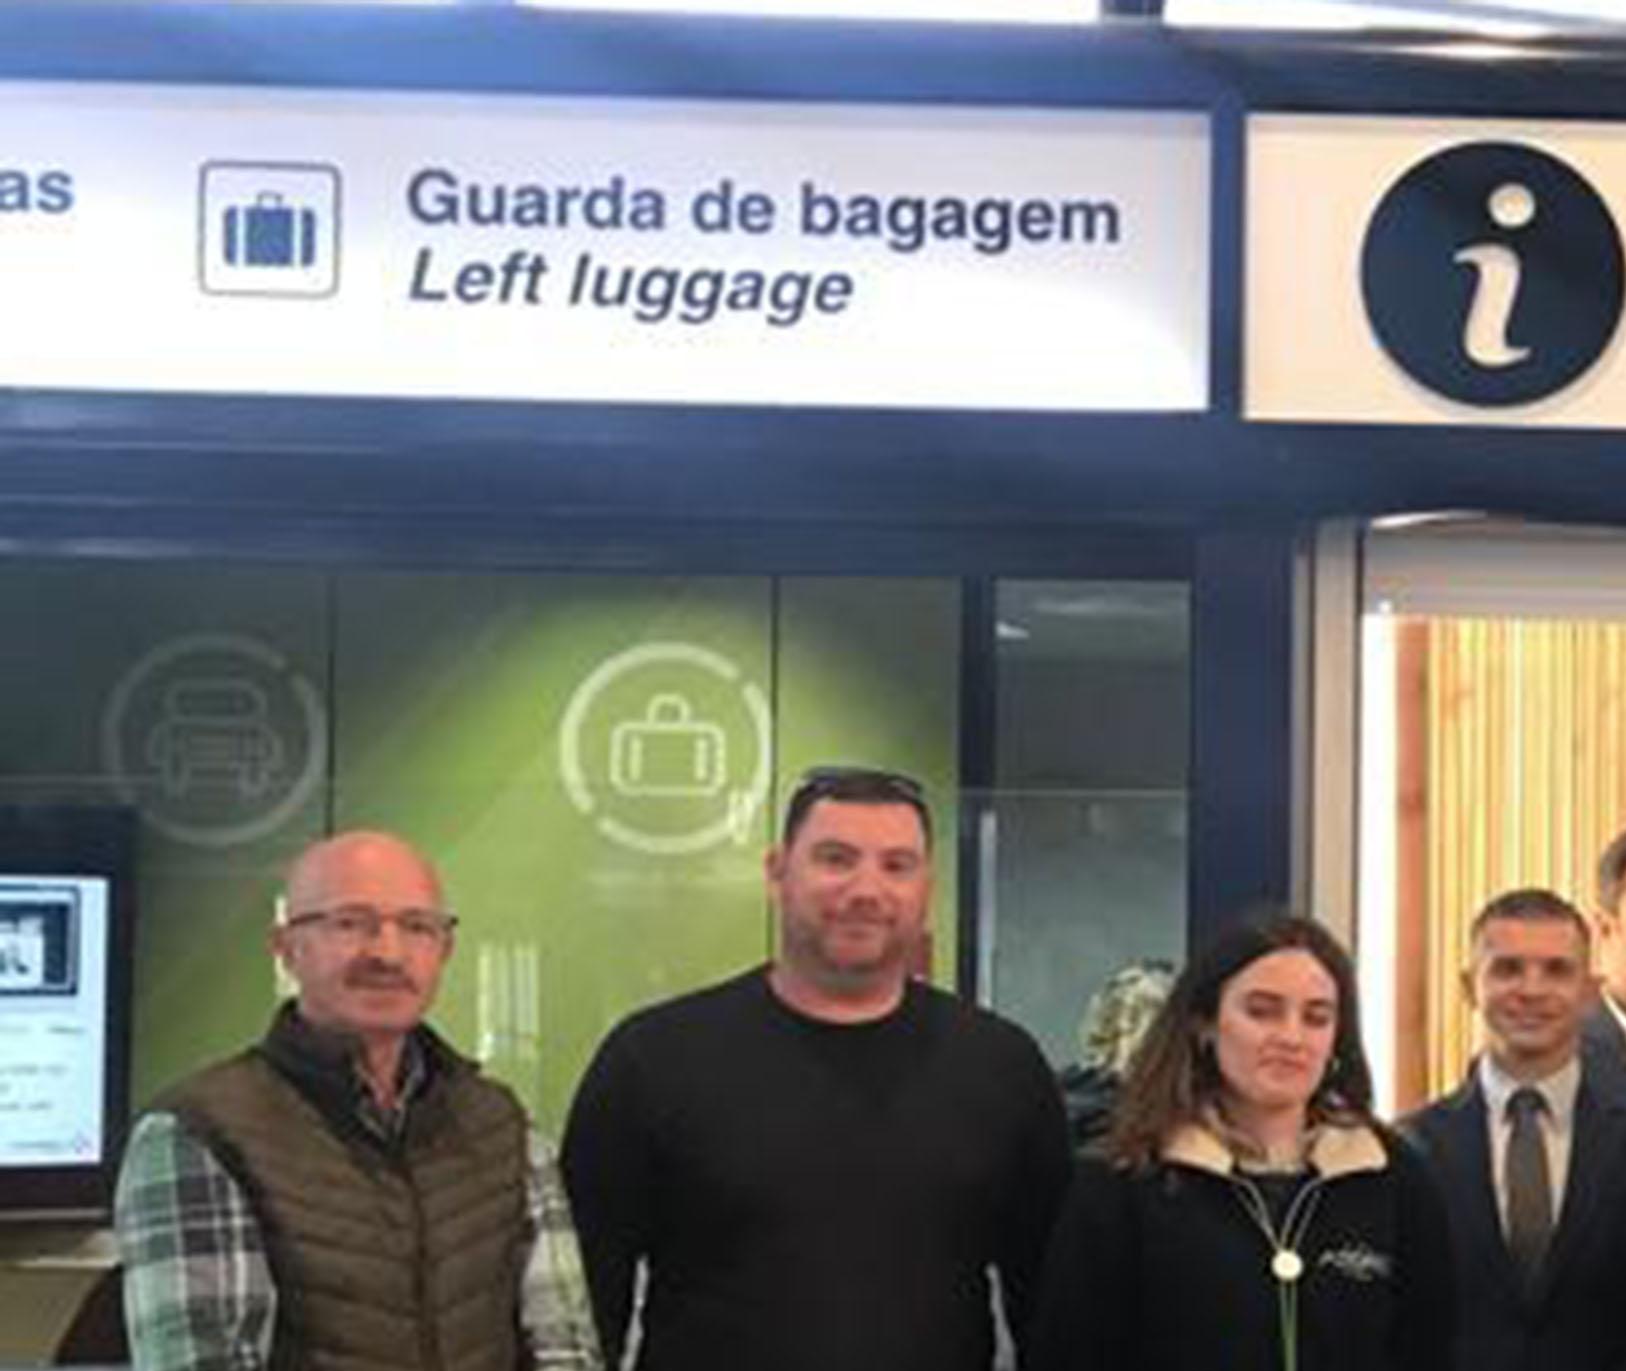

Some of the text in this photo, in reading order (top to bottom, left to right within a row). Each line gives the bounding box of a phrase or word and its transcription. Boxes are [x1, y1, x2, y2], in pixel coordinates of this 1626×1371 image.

[406, 168, 1121, 255] Guarda de bagagem
[409, 248, 854, 327] Left luggage
